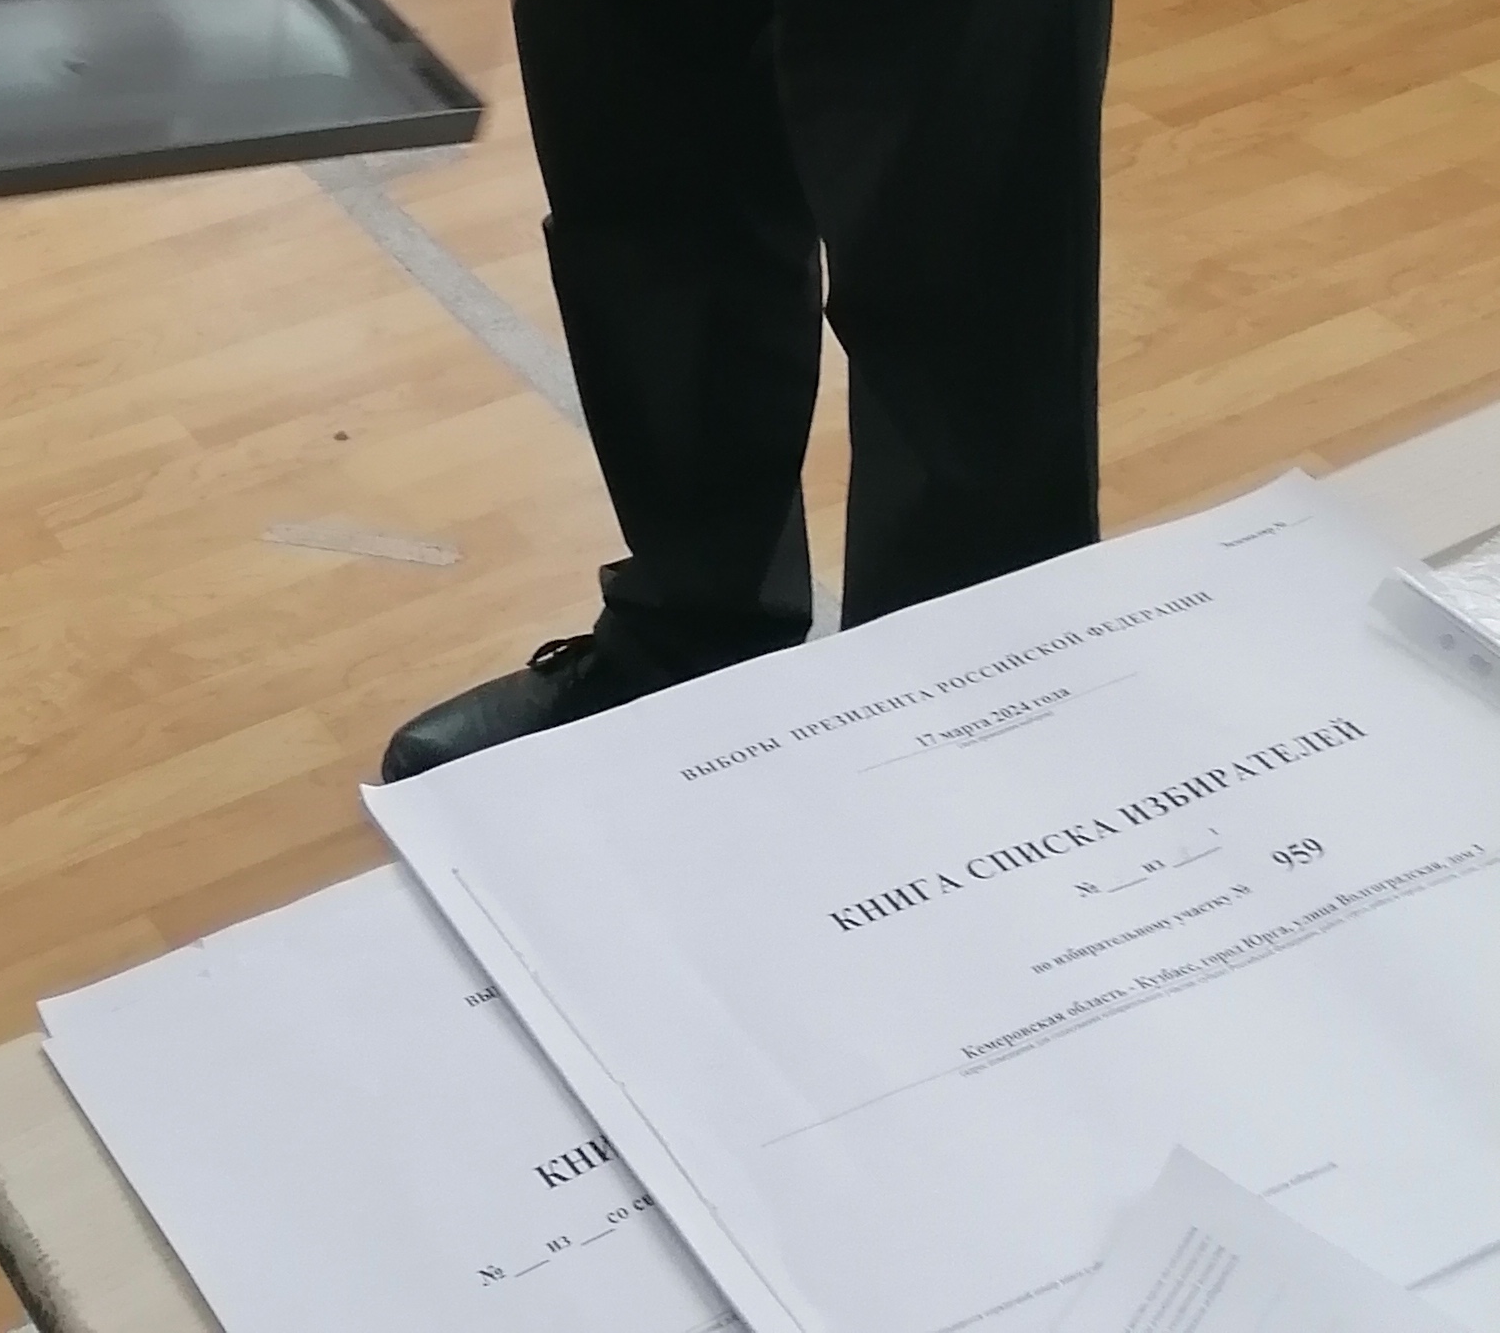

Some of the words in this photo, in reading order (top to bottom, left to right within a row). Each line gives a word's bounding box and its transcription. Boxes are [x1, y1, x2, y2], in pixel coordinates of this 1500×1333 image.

[678, 735, 782, 783] ВЫБОРЫ
[788, 688, 936, 742] ПРЕЗИДЕНТА
[935, 631, 1085, 695] РОССИЙСКОЙ
[1086, 589, 1216, 638] ФЕДЕРАЦИИ
[914, 731, 935, 749] 17
[937, 717, 992, 741] марта
[990, 699, 1032, 723] 2024
[828, 872, 965, 935] КНИГА
[966, 817, 1123, 881] СПИСКА
[1116, 716, 1370, 827] ИЗБИРАТЕЛЕЙ
[1270, 837, 1325, 872] 959
[1030, 960, 1053, 975] по
[1053, 917, 1174, 965] избирательному
[1173, 894, 1233, 927] участку
[463, 985, 501, 1008] ВЫ
[960, 1012, 1067, 1060] Кемеровская
[534, 1133, 615, 1190] КНИ
[476, 1264, 507, 1287] №
[546, 1235, 572, 1254] из
[606, 1206, 629, 1225] со
